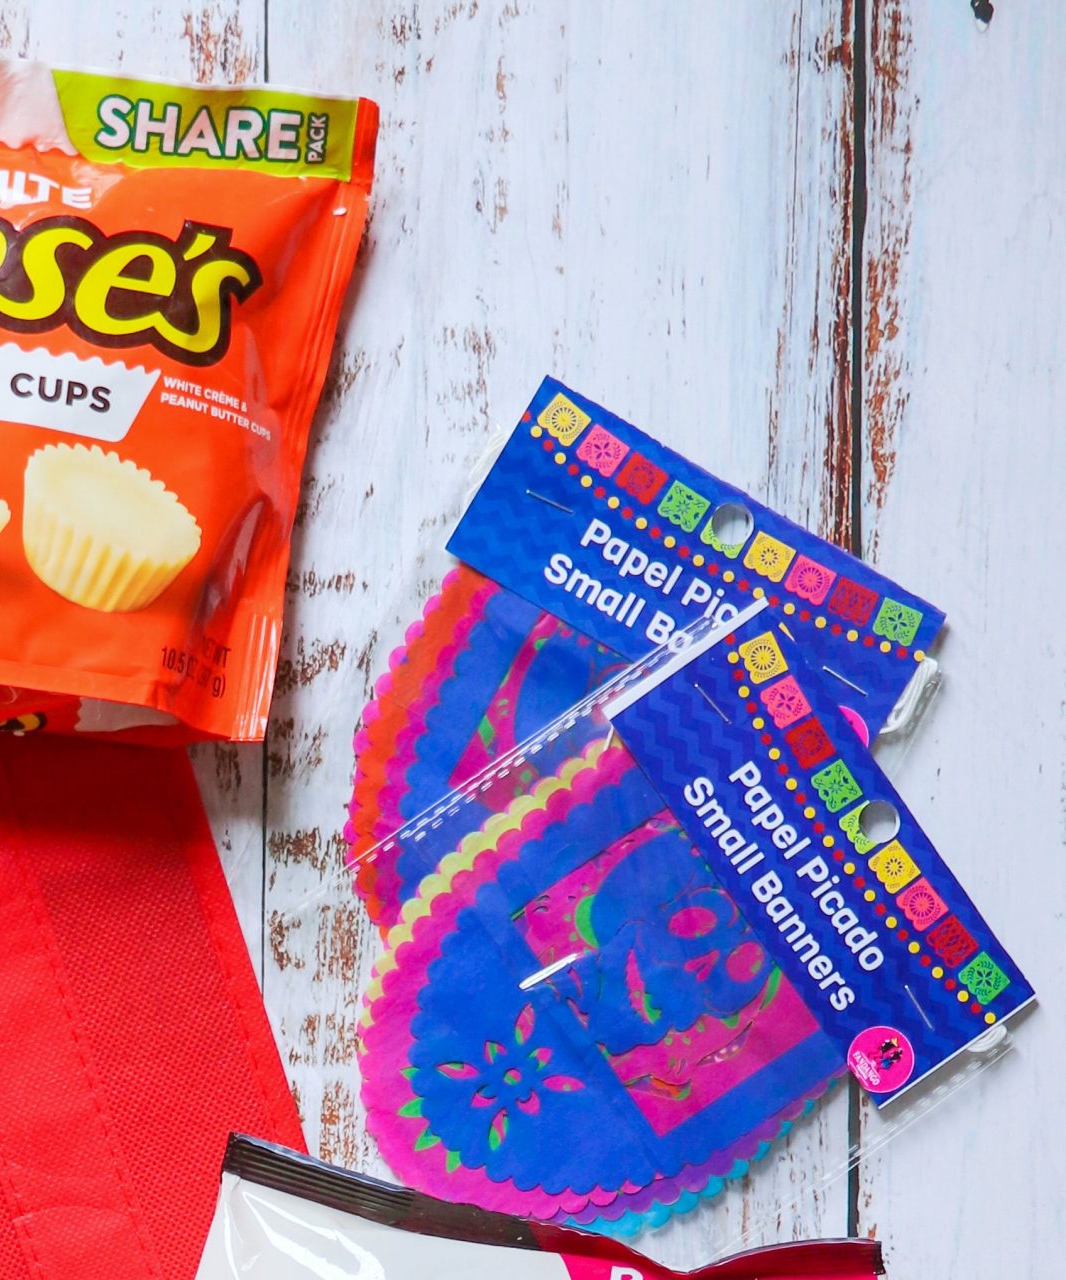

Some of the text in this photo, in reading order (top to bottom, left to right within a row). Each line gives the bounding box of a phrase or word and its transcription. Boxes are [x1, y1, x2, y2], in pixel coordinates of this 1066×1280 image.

[95, 95, 303, 161] SHARE
[307, 113, 328, 163] PACK
[9, 371, 113, 414] CUPS
[160, 392, 272, 442] PEANUT BUTTER CUPS
[163, 376, 202, 396] WHITE
[203, 388, 239, 410] CRÈME
[543, 553, 647, 629] Small
[579, 518, 740, 627] Papel Pic
[682, 775, 856, 1014] Small Banners
[728, 760, 885, 973] Papel Picado
